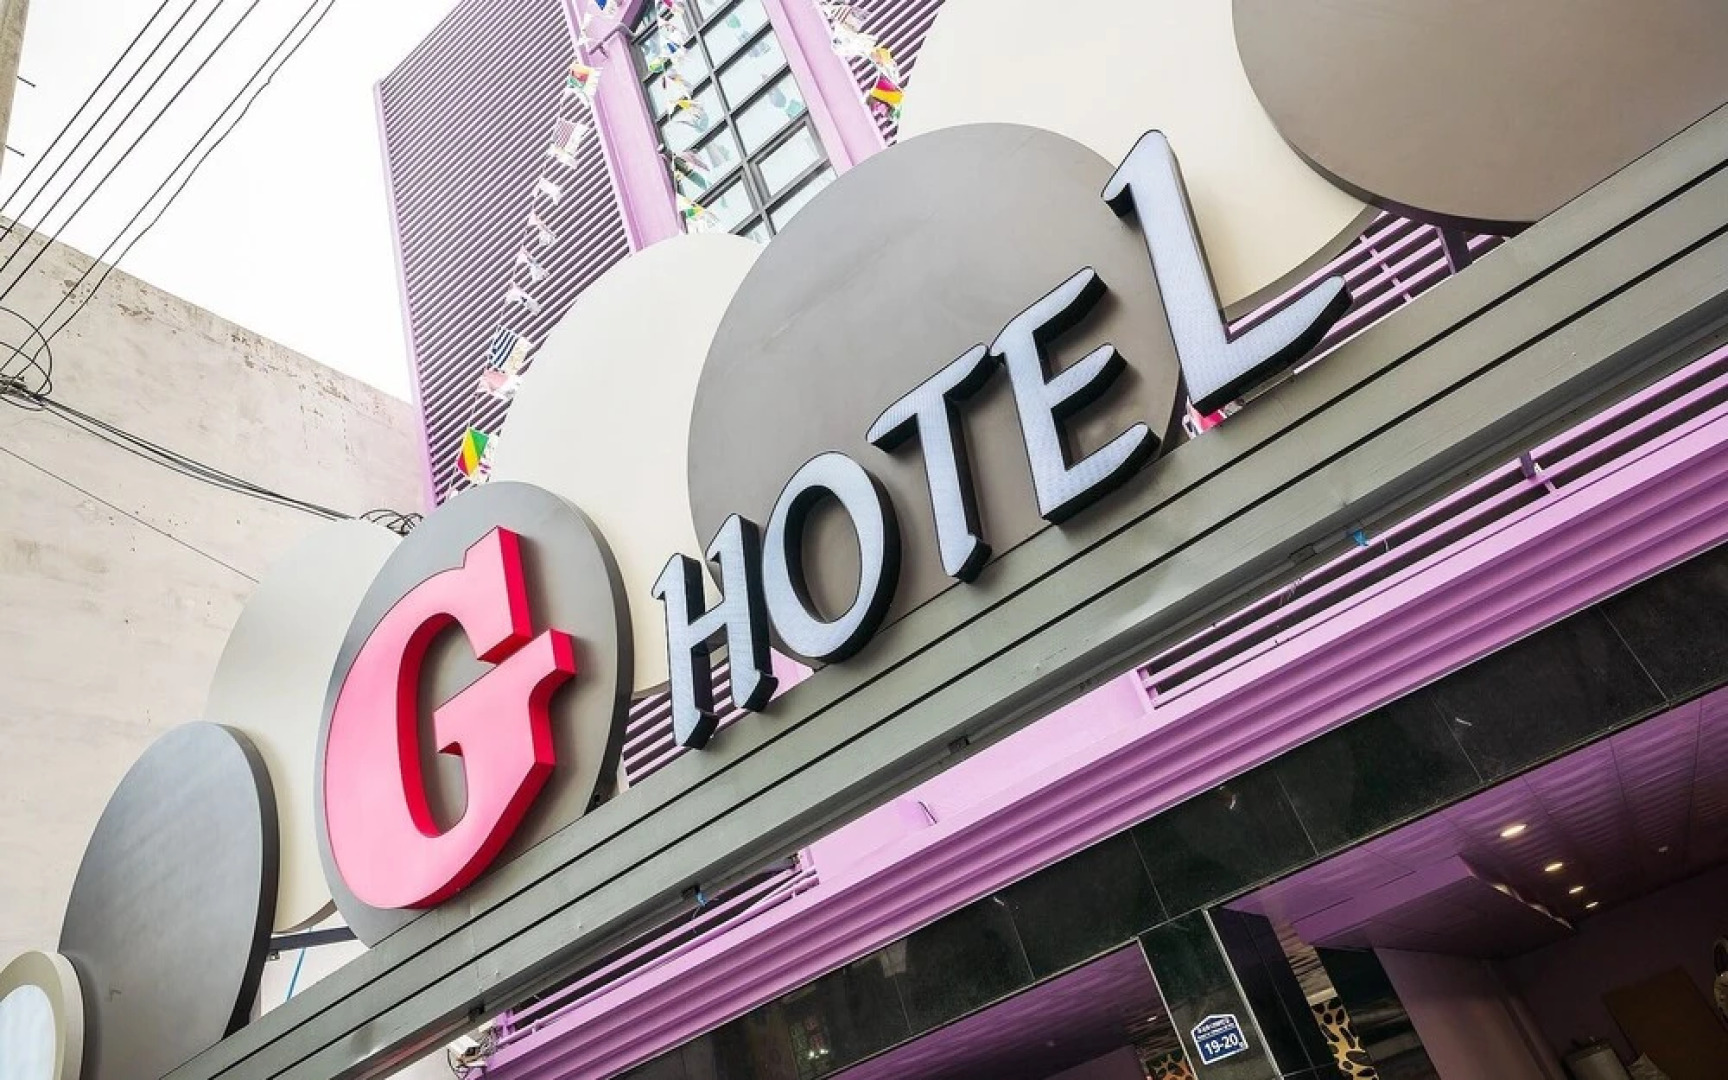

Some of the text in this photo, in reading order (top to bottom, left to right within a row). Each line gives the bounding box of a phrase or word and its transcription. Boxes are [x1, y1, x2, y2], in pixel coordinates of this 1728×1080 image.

[323, 129, 1350, 909] G HOTEL
[1204, 1033, 1238, 1055] 19-20
